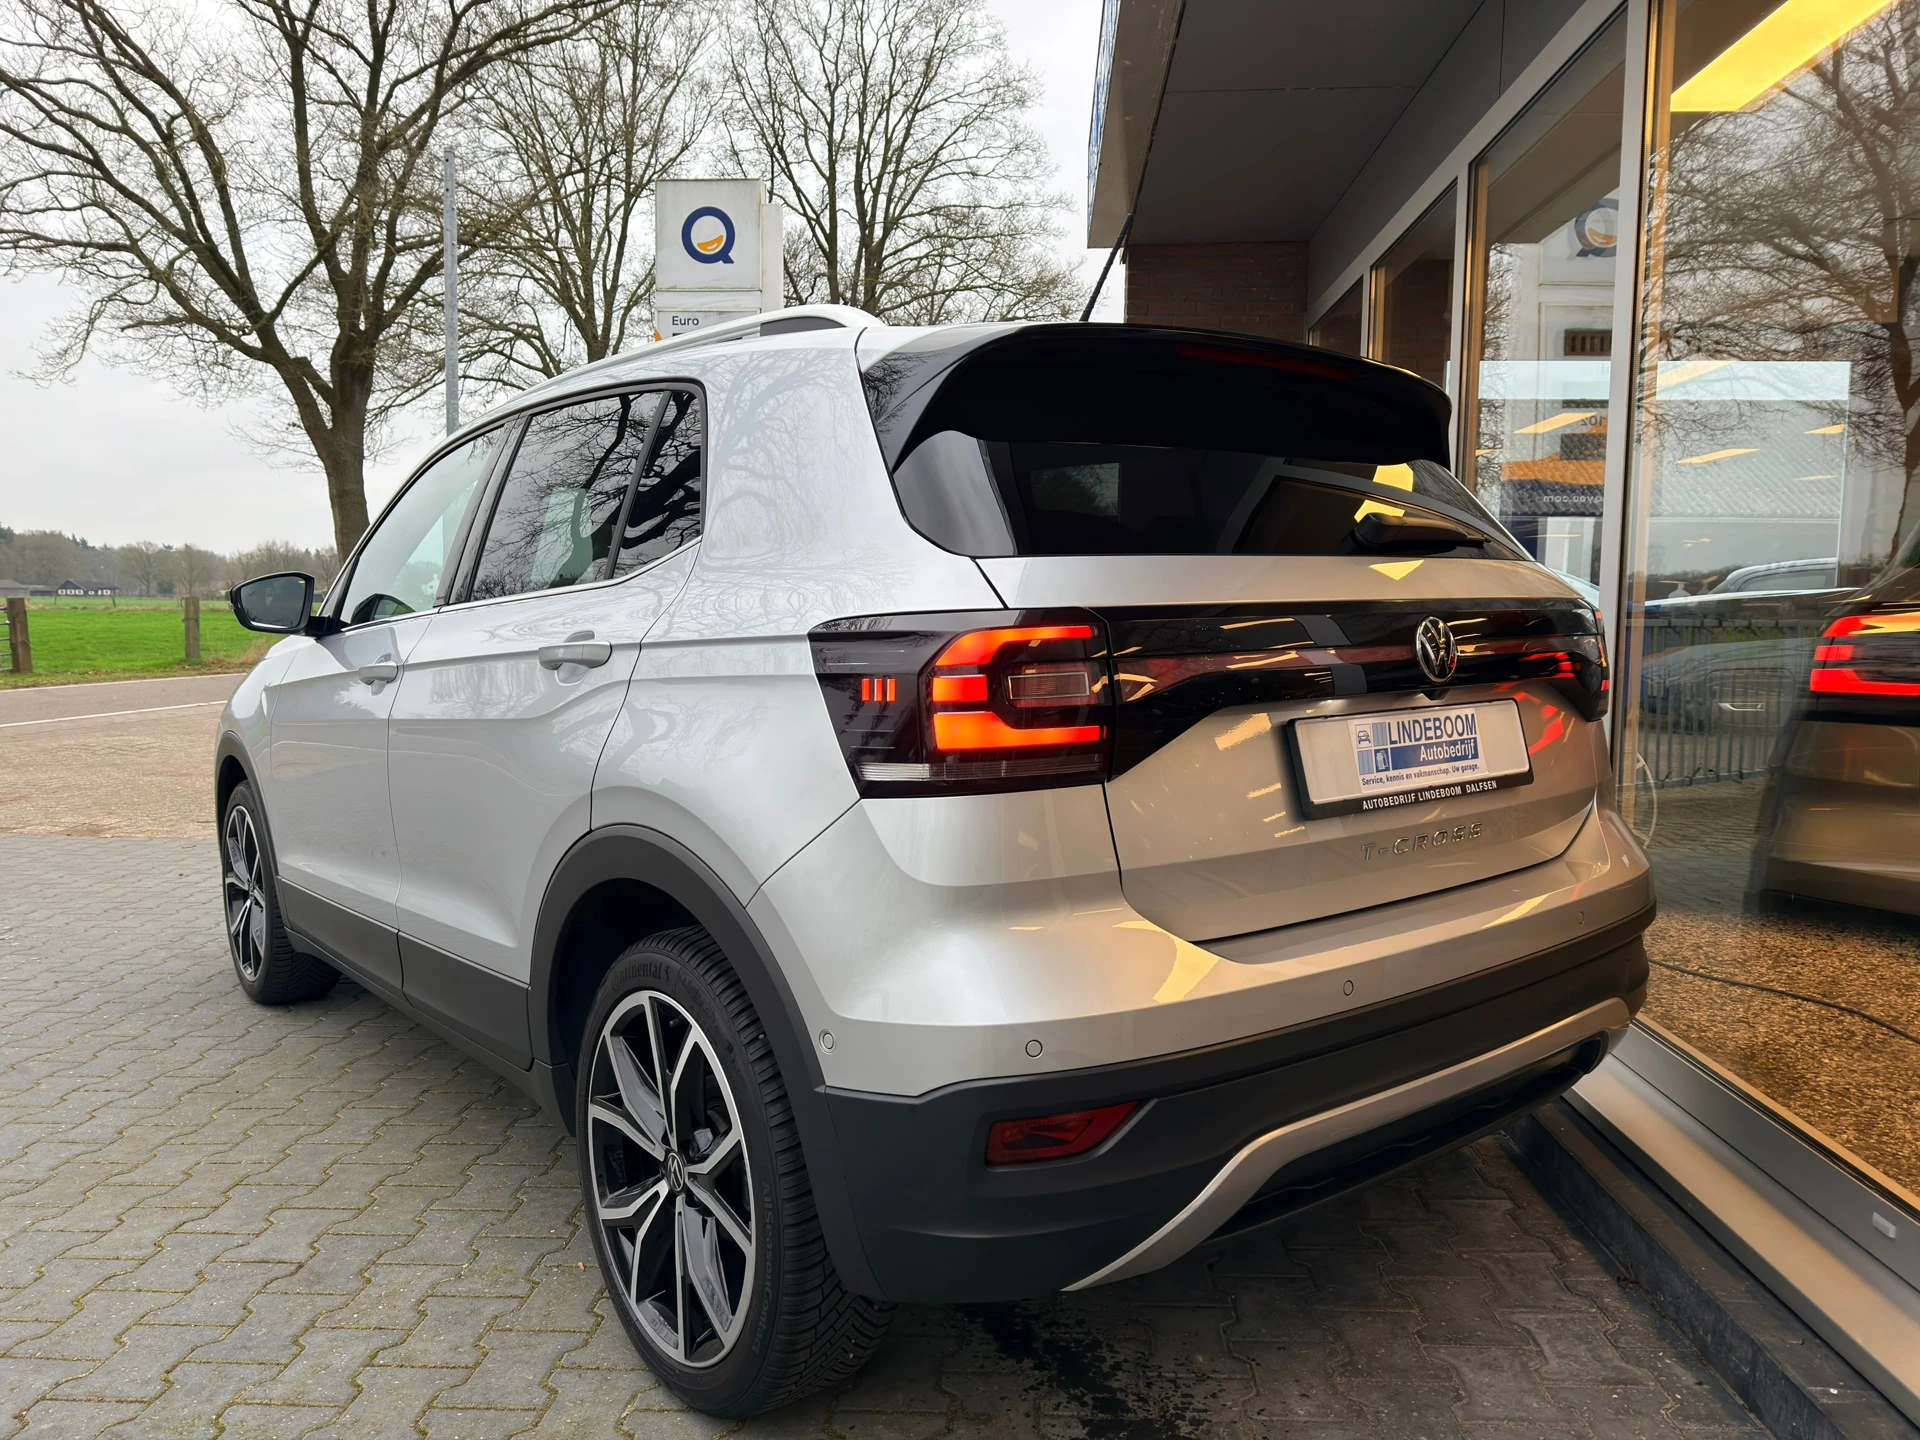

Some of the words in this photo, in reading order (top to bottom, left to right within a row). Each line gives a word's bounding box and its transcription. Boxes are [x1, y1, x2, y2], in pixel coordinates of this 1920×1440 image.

[671, 315, 699, 326] Euro
[1387, 713, 1477, 745] LINDEBOOM
[1420, 739, 1475, 761] Autobedrijf
[1361, 775, 1385, 786] Service,
[1386, 773, 1405, 782] kennis
[1406, 772, 1413, 780] en
[1413, 767, 1451, 779] vakmanschap.
[1452, 765, 1460, 773] Uw
[1461, 764, 1480, 774] garage.
[1363, 793, 1416, 810] AUTOBEDRIJF
[1418, 786, 1462, 801] LINDEBOOM
[1466, 780, 1498, 793] DALFSEN
[1361, 821, 1483, 861] T-CROSS
[611, 961, 663, 992] Continental
